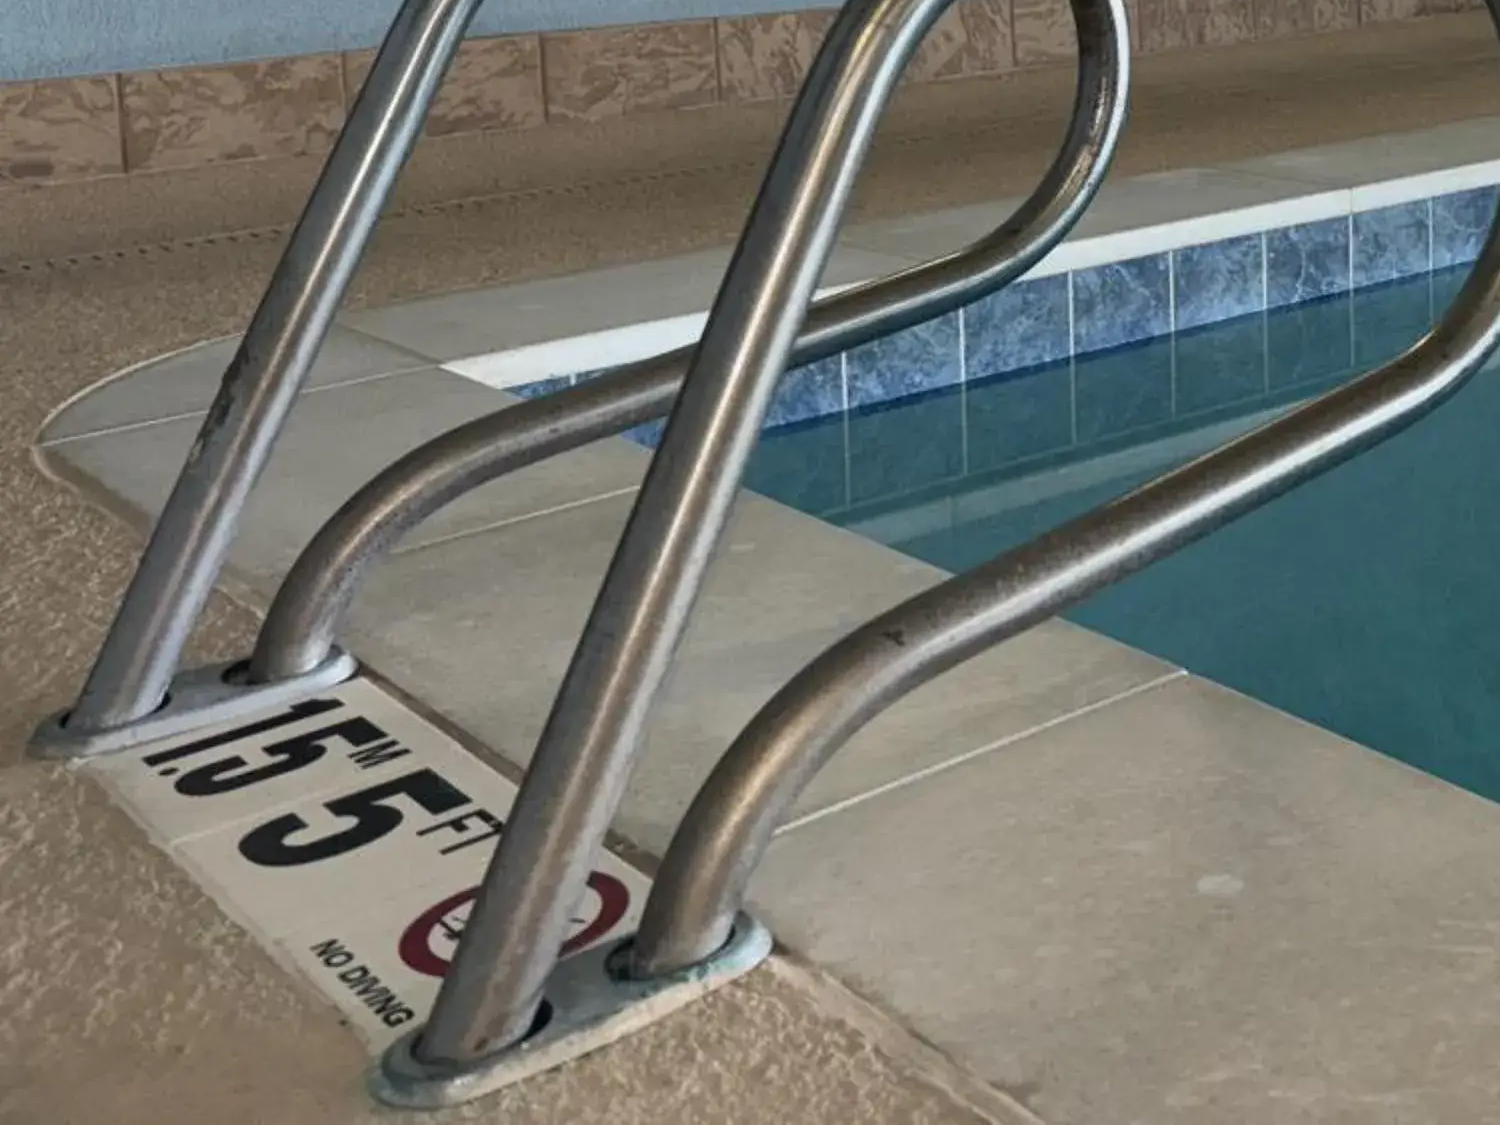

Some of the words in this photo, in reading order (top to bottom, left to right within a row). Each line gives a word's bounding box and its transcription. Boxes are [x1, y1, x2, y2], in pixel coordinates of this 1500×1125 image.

[141, 698, 388, 796] 1.5
[237, 768, 473, 867] 5
[415, 808, 504, 856] FT
[308, 938, 355, 968] NO
[337, 965, 415, 1028] DIVING
